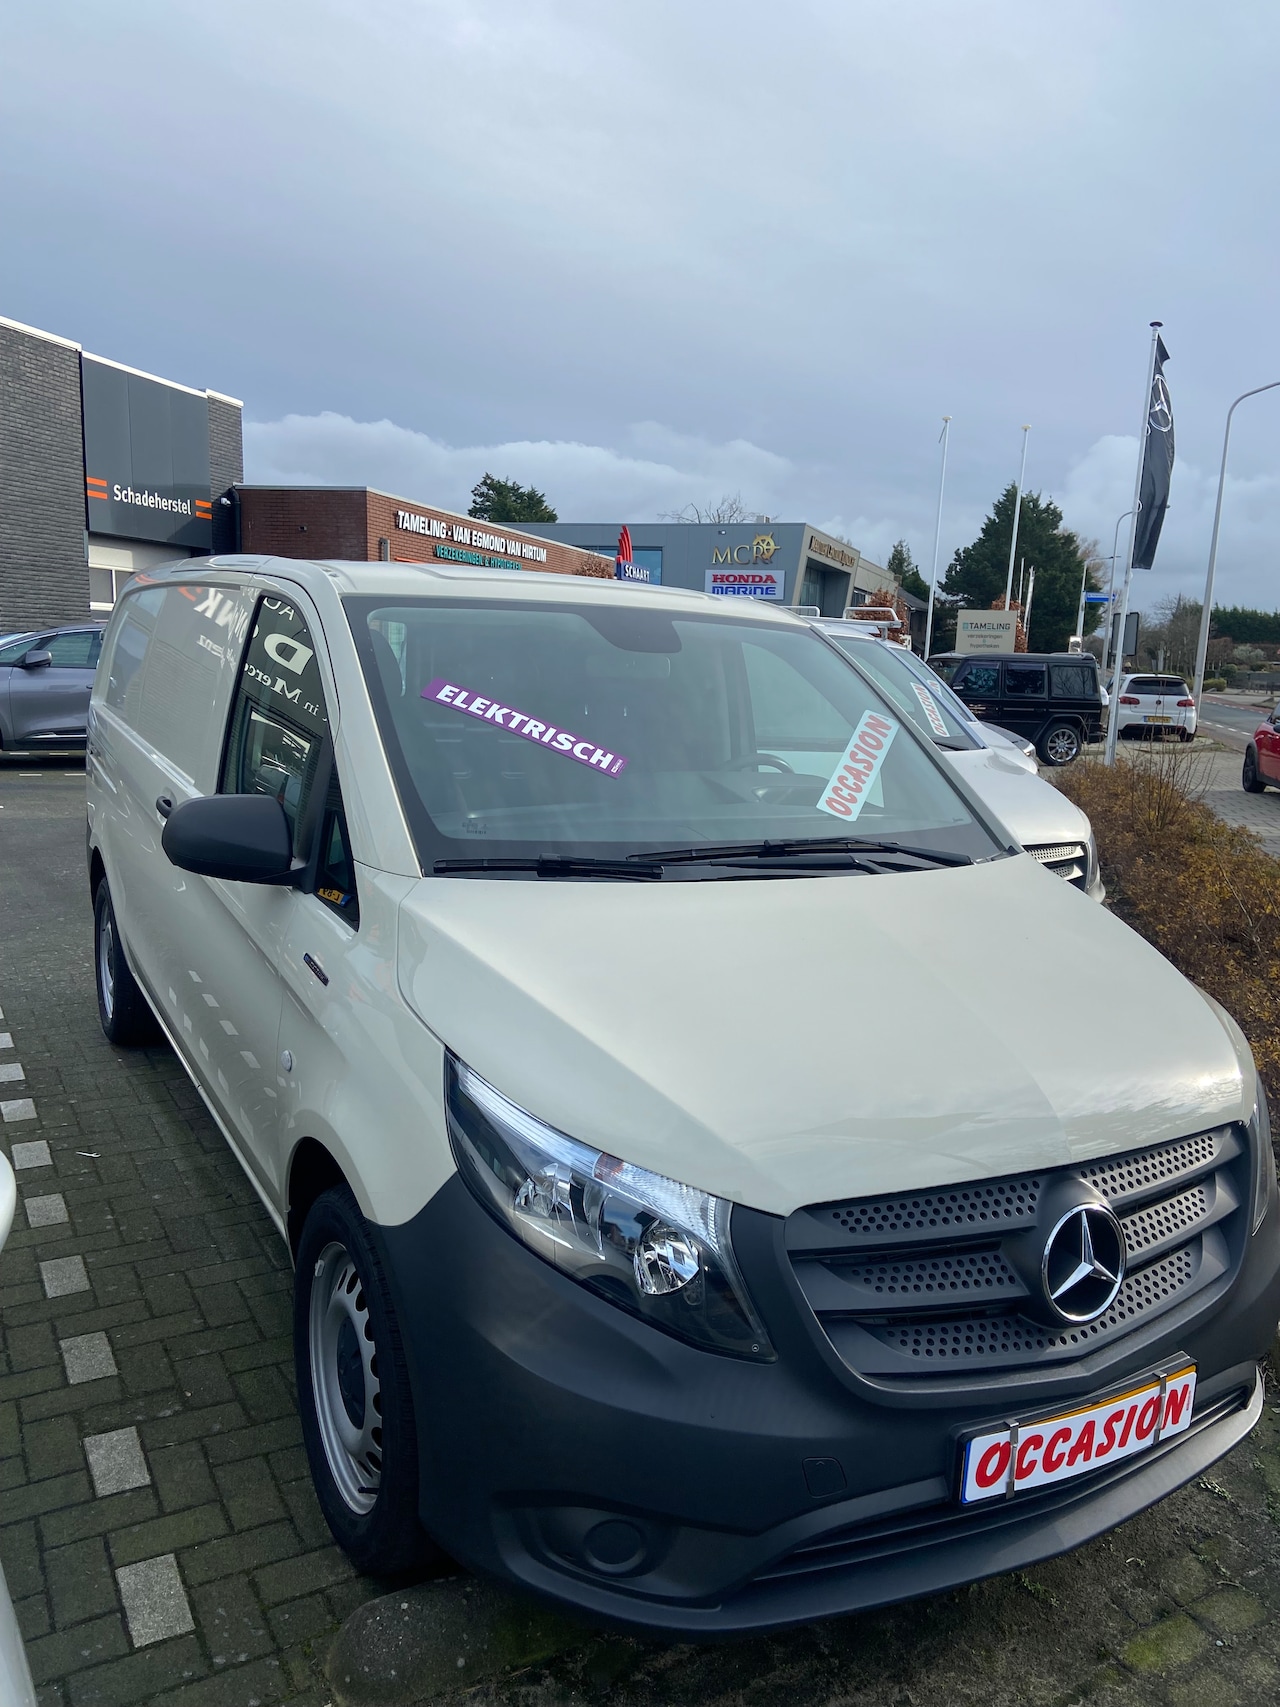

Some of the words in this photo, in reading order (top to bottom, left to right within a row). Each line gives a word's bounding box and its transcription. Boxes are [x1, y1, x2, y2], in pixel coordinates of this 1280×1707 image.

[113, 484, 192, 515] Schadeherstel
[397, 510, 447, 539] TAMELING
[452, 524, 471, 545] VAN
[471, 529, 506, 553] EGMOND
[506, 539, 522, 557] VAN
[521, 543, 547, 563] HIRTUM
[712, 544, 773, 565] MCR
[624, 564, 650, 582] SCHAART
[711, 573, 777, 584] HONDA
[969, 622, 1011, 630] TAMELING
[436, 684, 614, 770] ELEKTRISCH
[825, 714, 882, 816] OCCASION
[975, 1384, 1189, 1488] OCCASION
